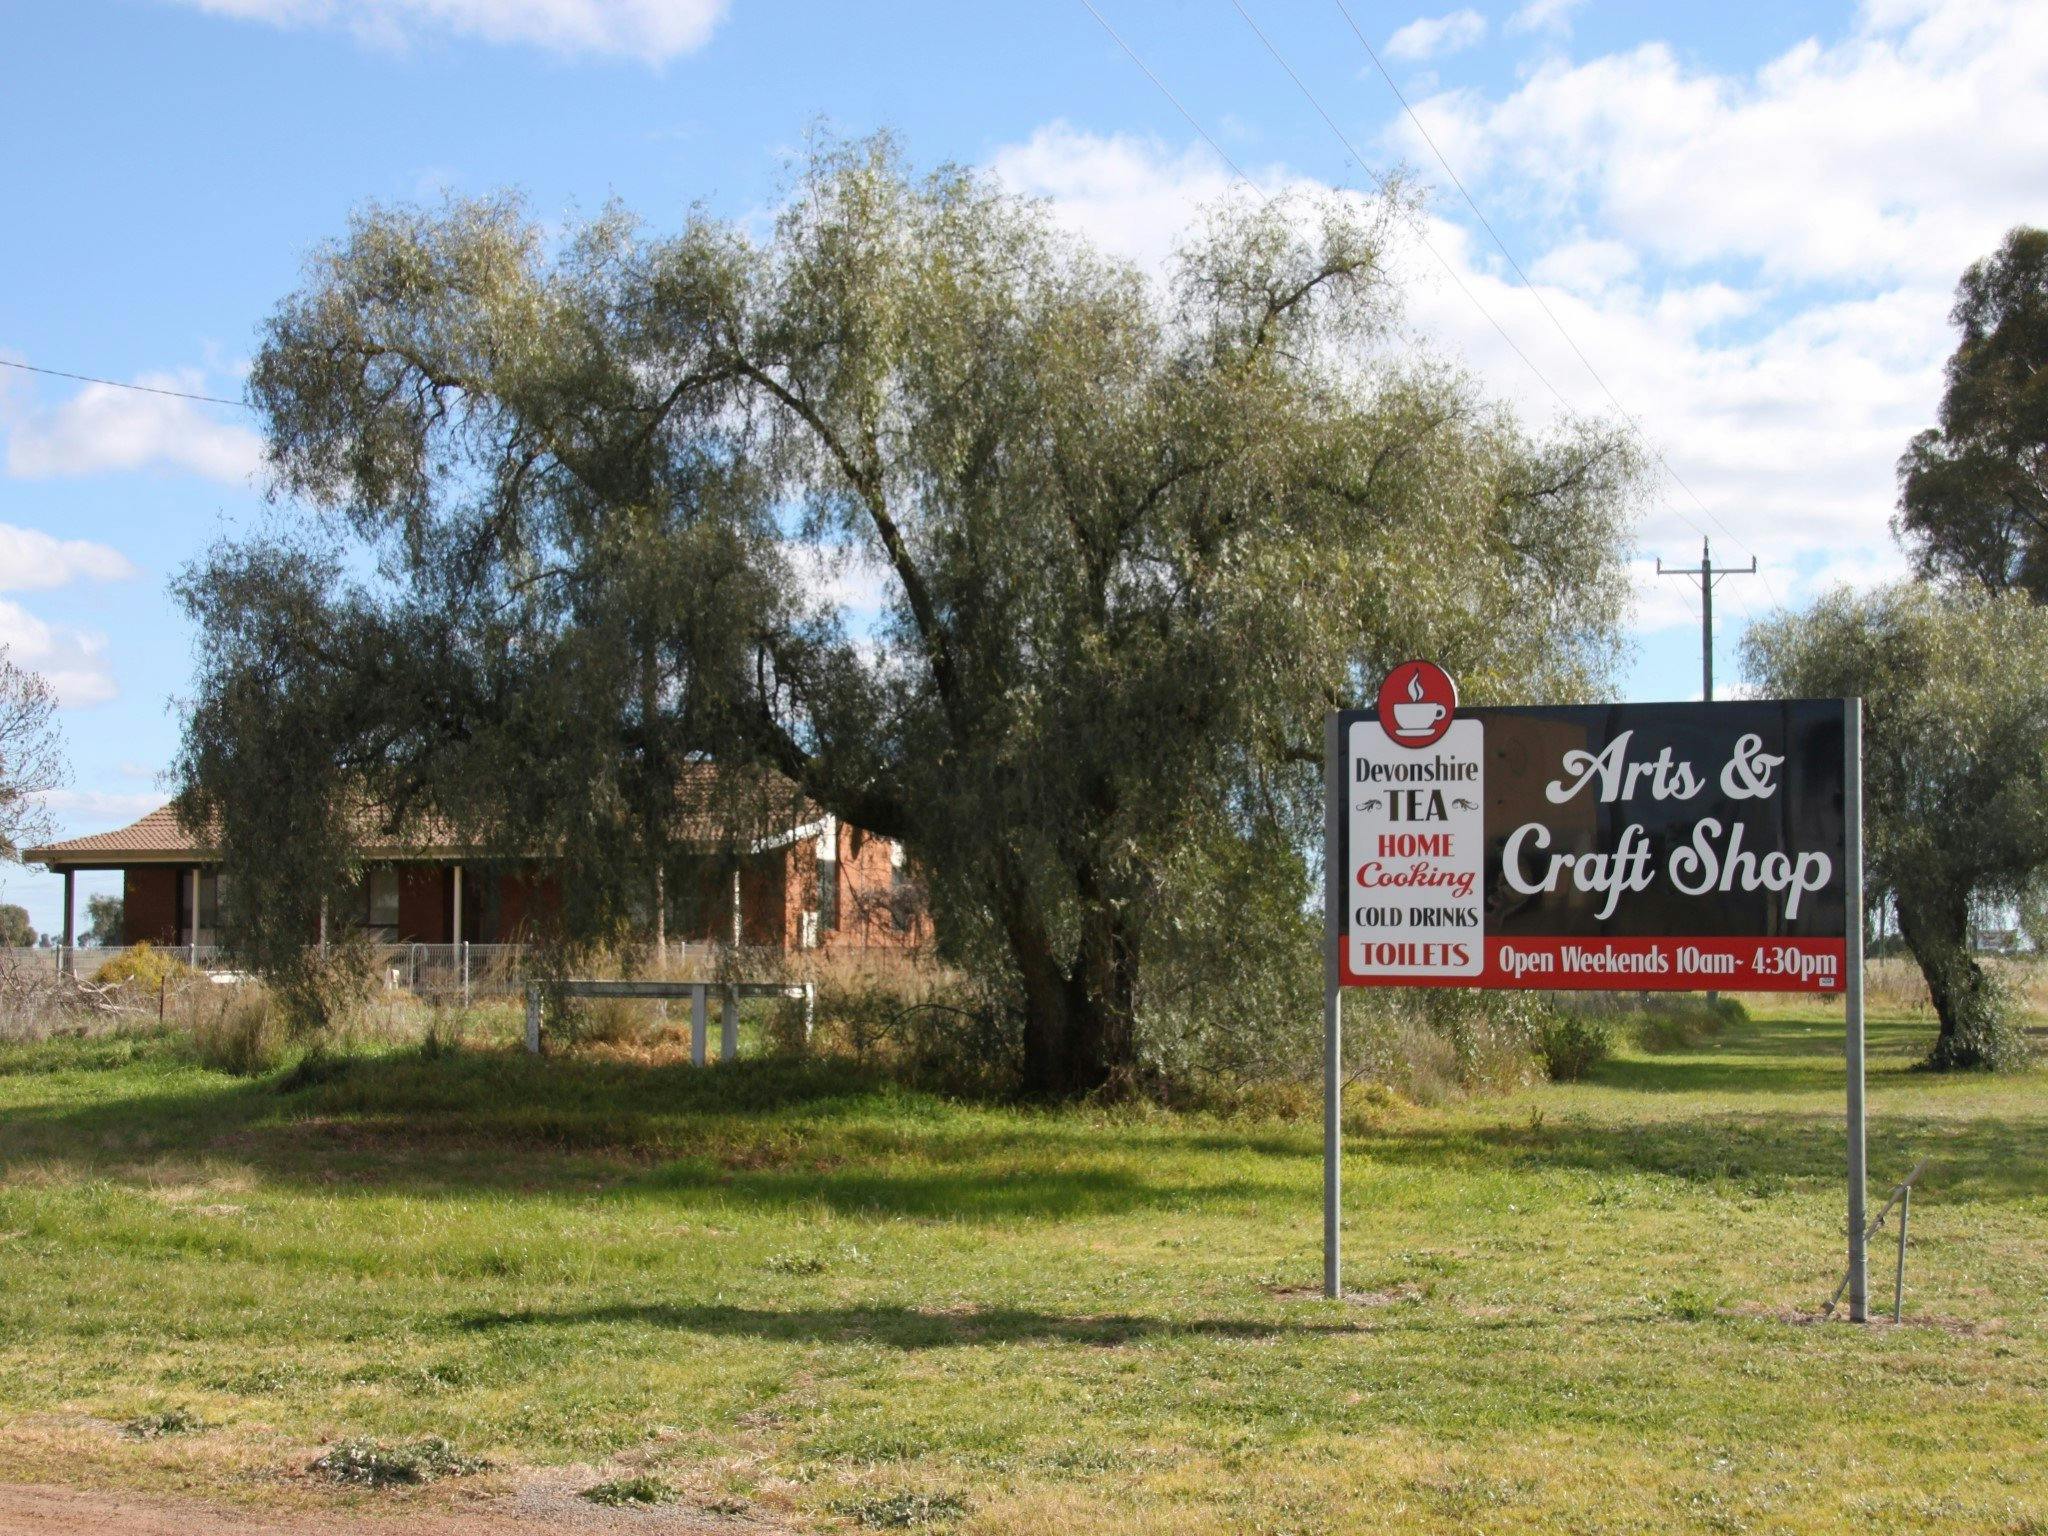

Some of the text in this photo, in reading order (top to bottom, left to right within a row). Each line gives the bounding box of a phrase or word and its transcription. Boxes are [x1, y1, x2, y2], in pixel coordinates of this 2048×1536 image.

[1355, 755, 1479, 783] Devonshire
[1545, 729, 1785, 804] Arts &
[1383, 789, 1449, 821] TEA
[1378, 833, 1455, 857] HOME
[1356, 861, 1475, 898] Cooking
[1502, 817, 1833, 920] Craft Shop
[1355, 906, 1478, 927] COLD DRINKS
[1361, 942, 1470, 967] TOILETS
[1499, 945, 1554, 979] Open
[1560, 945, 1669, 974] Weekends
[1751, 946, 1837, 982] 4:30pm
